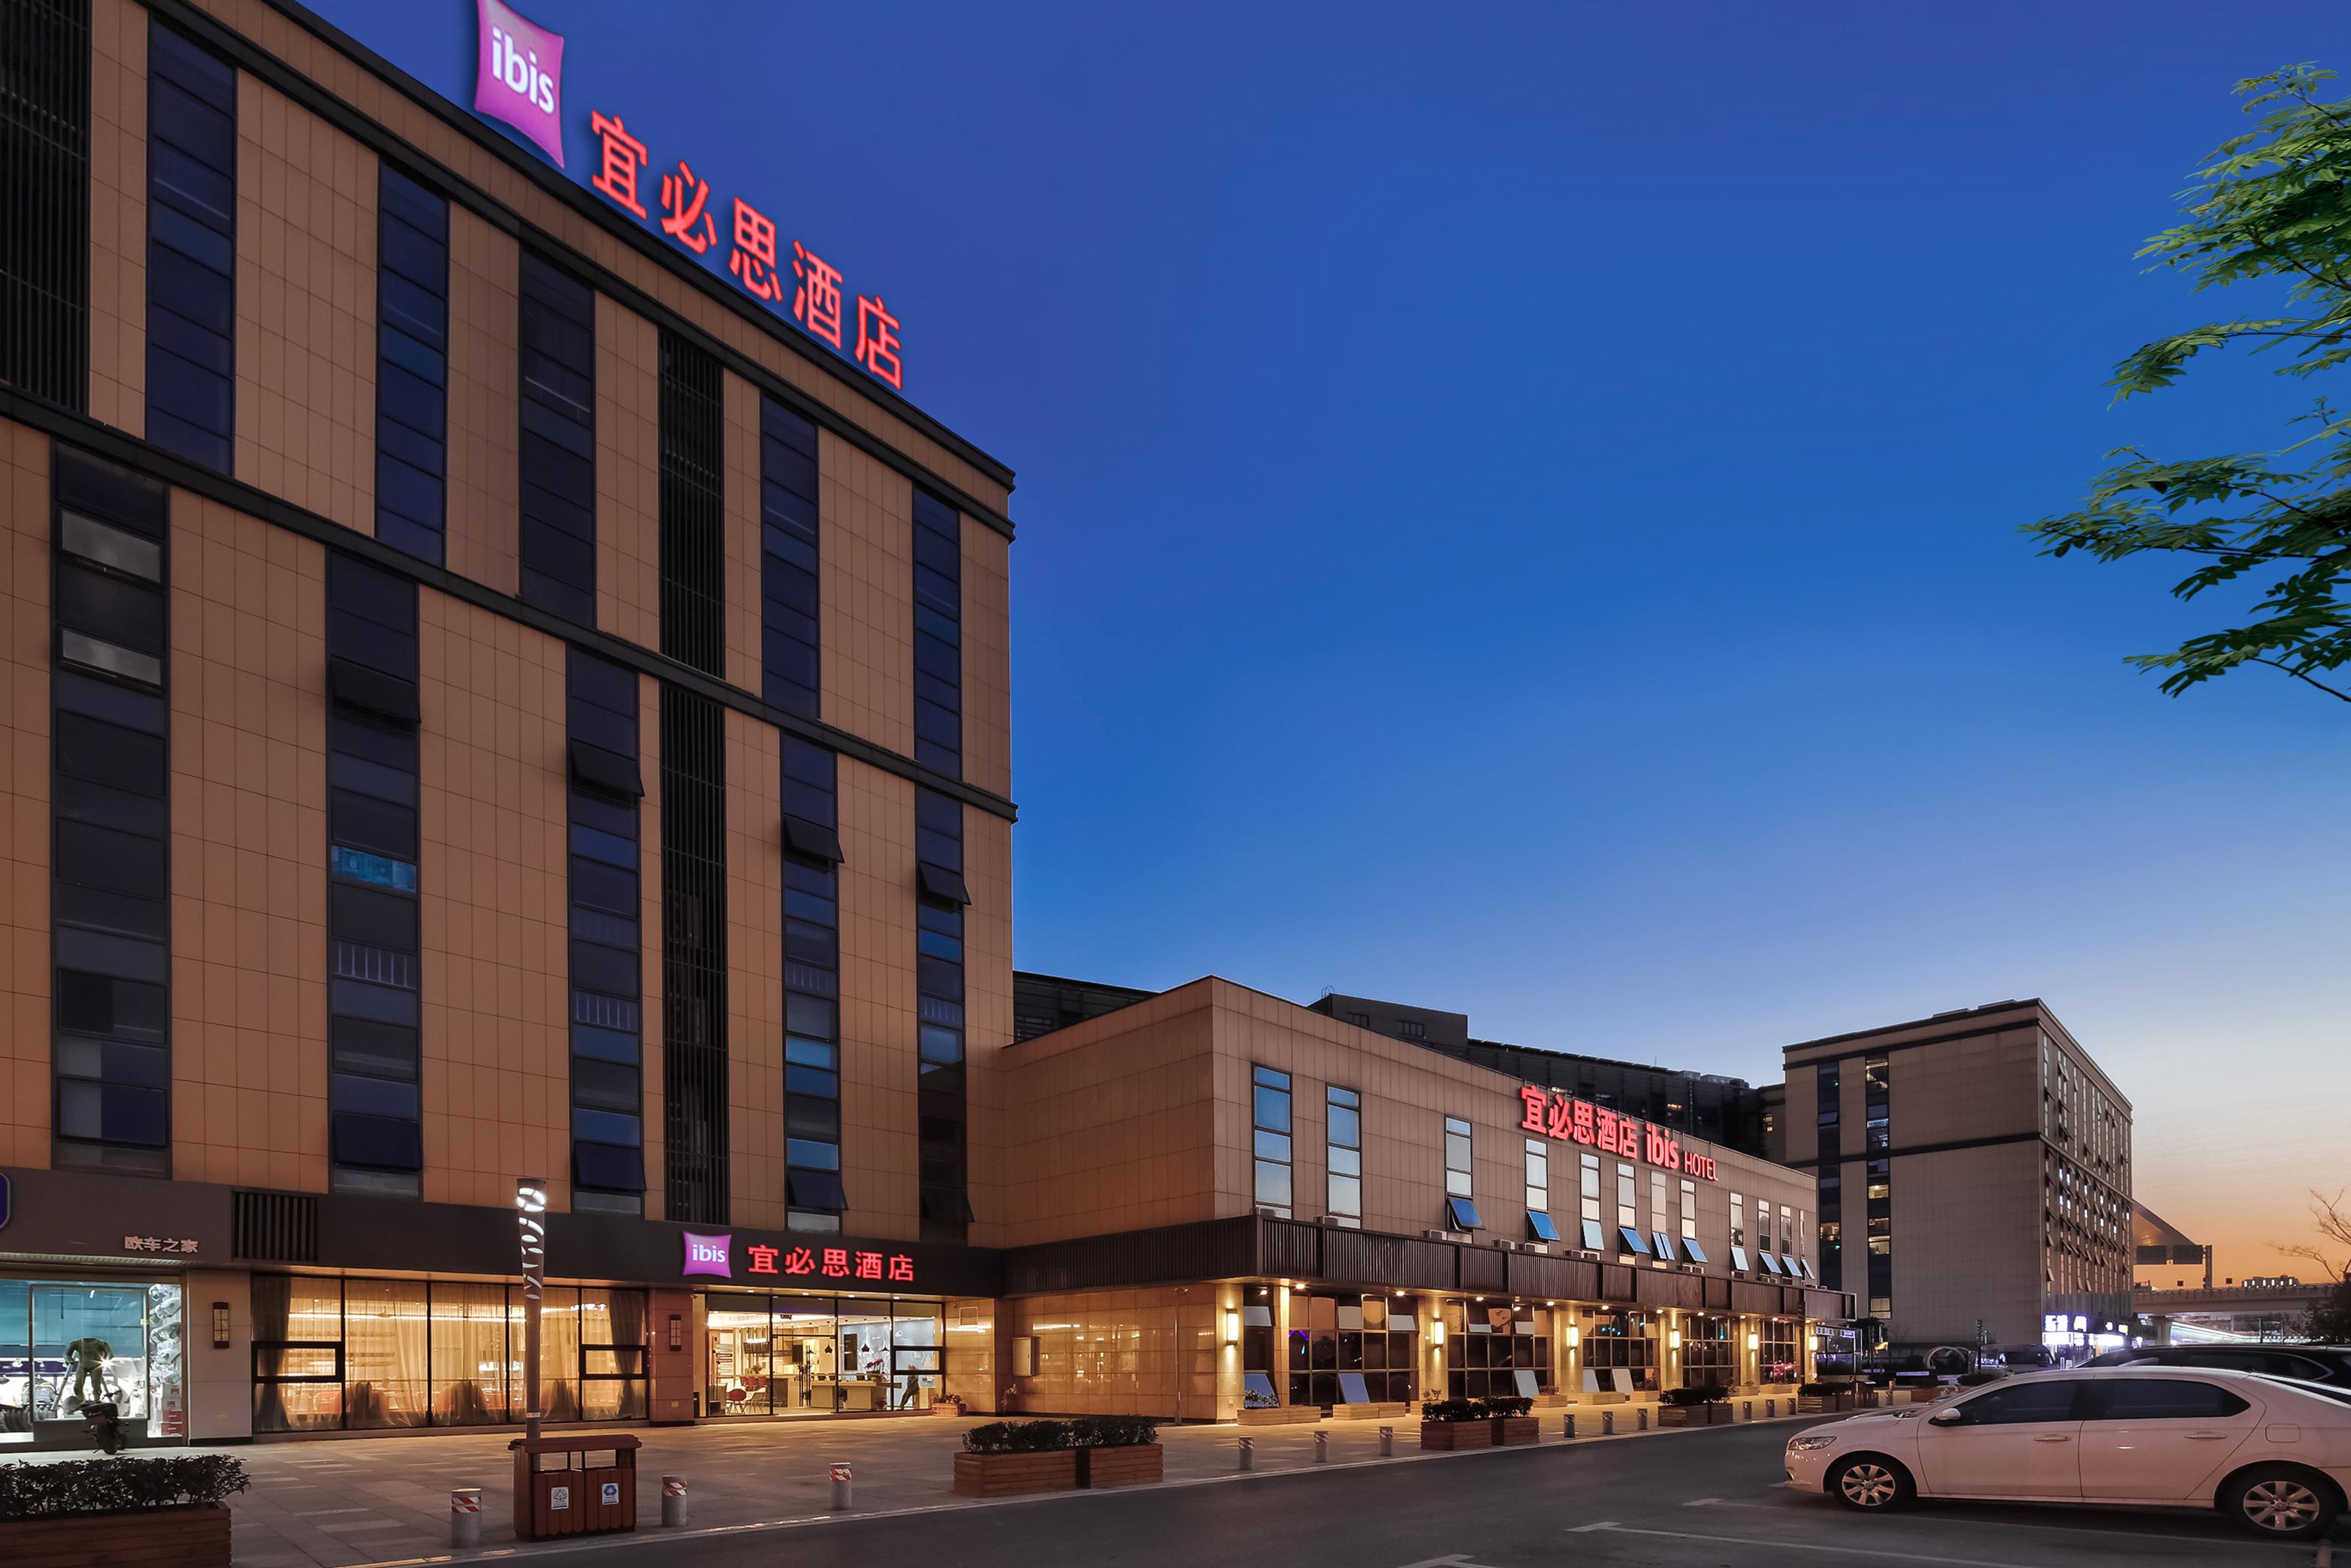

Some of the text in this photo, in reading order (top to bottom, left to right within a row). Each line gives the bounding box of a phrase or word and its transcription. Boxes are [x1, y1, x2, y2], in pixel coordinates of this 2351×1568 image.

[491, 26, 555, 115] ibis
[591, 109, 902, 390] 宜必思酒店
[1521, 1085, 1719, 1181] 宜必思酒店 ibis HOTEL
[124, 1236, 198, 1253] 欧车之家
[692, 1244, 726, 1264] ibis
[748, 1243, 914, 1282] 宜必思酒店
